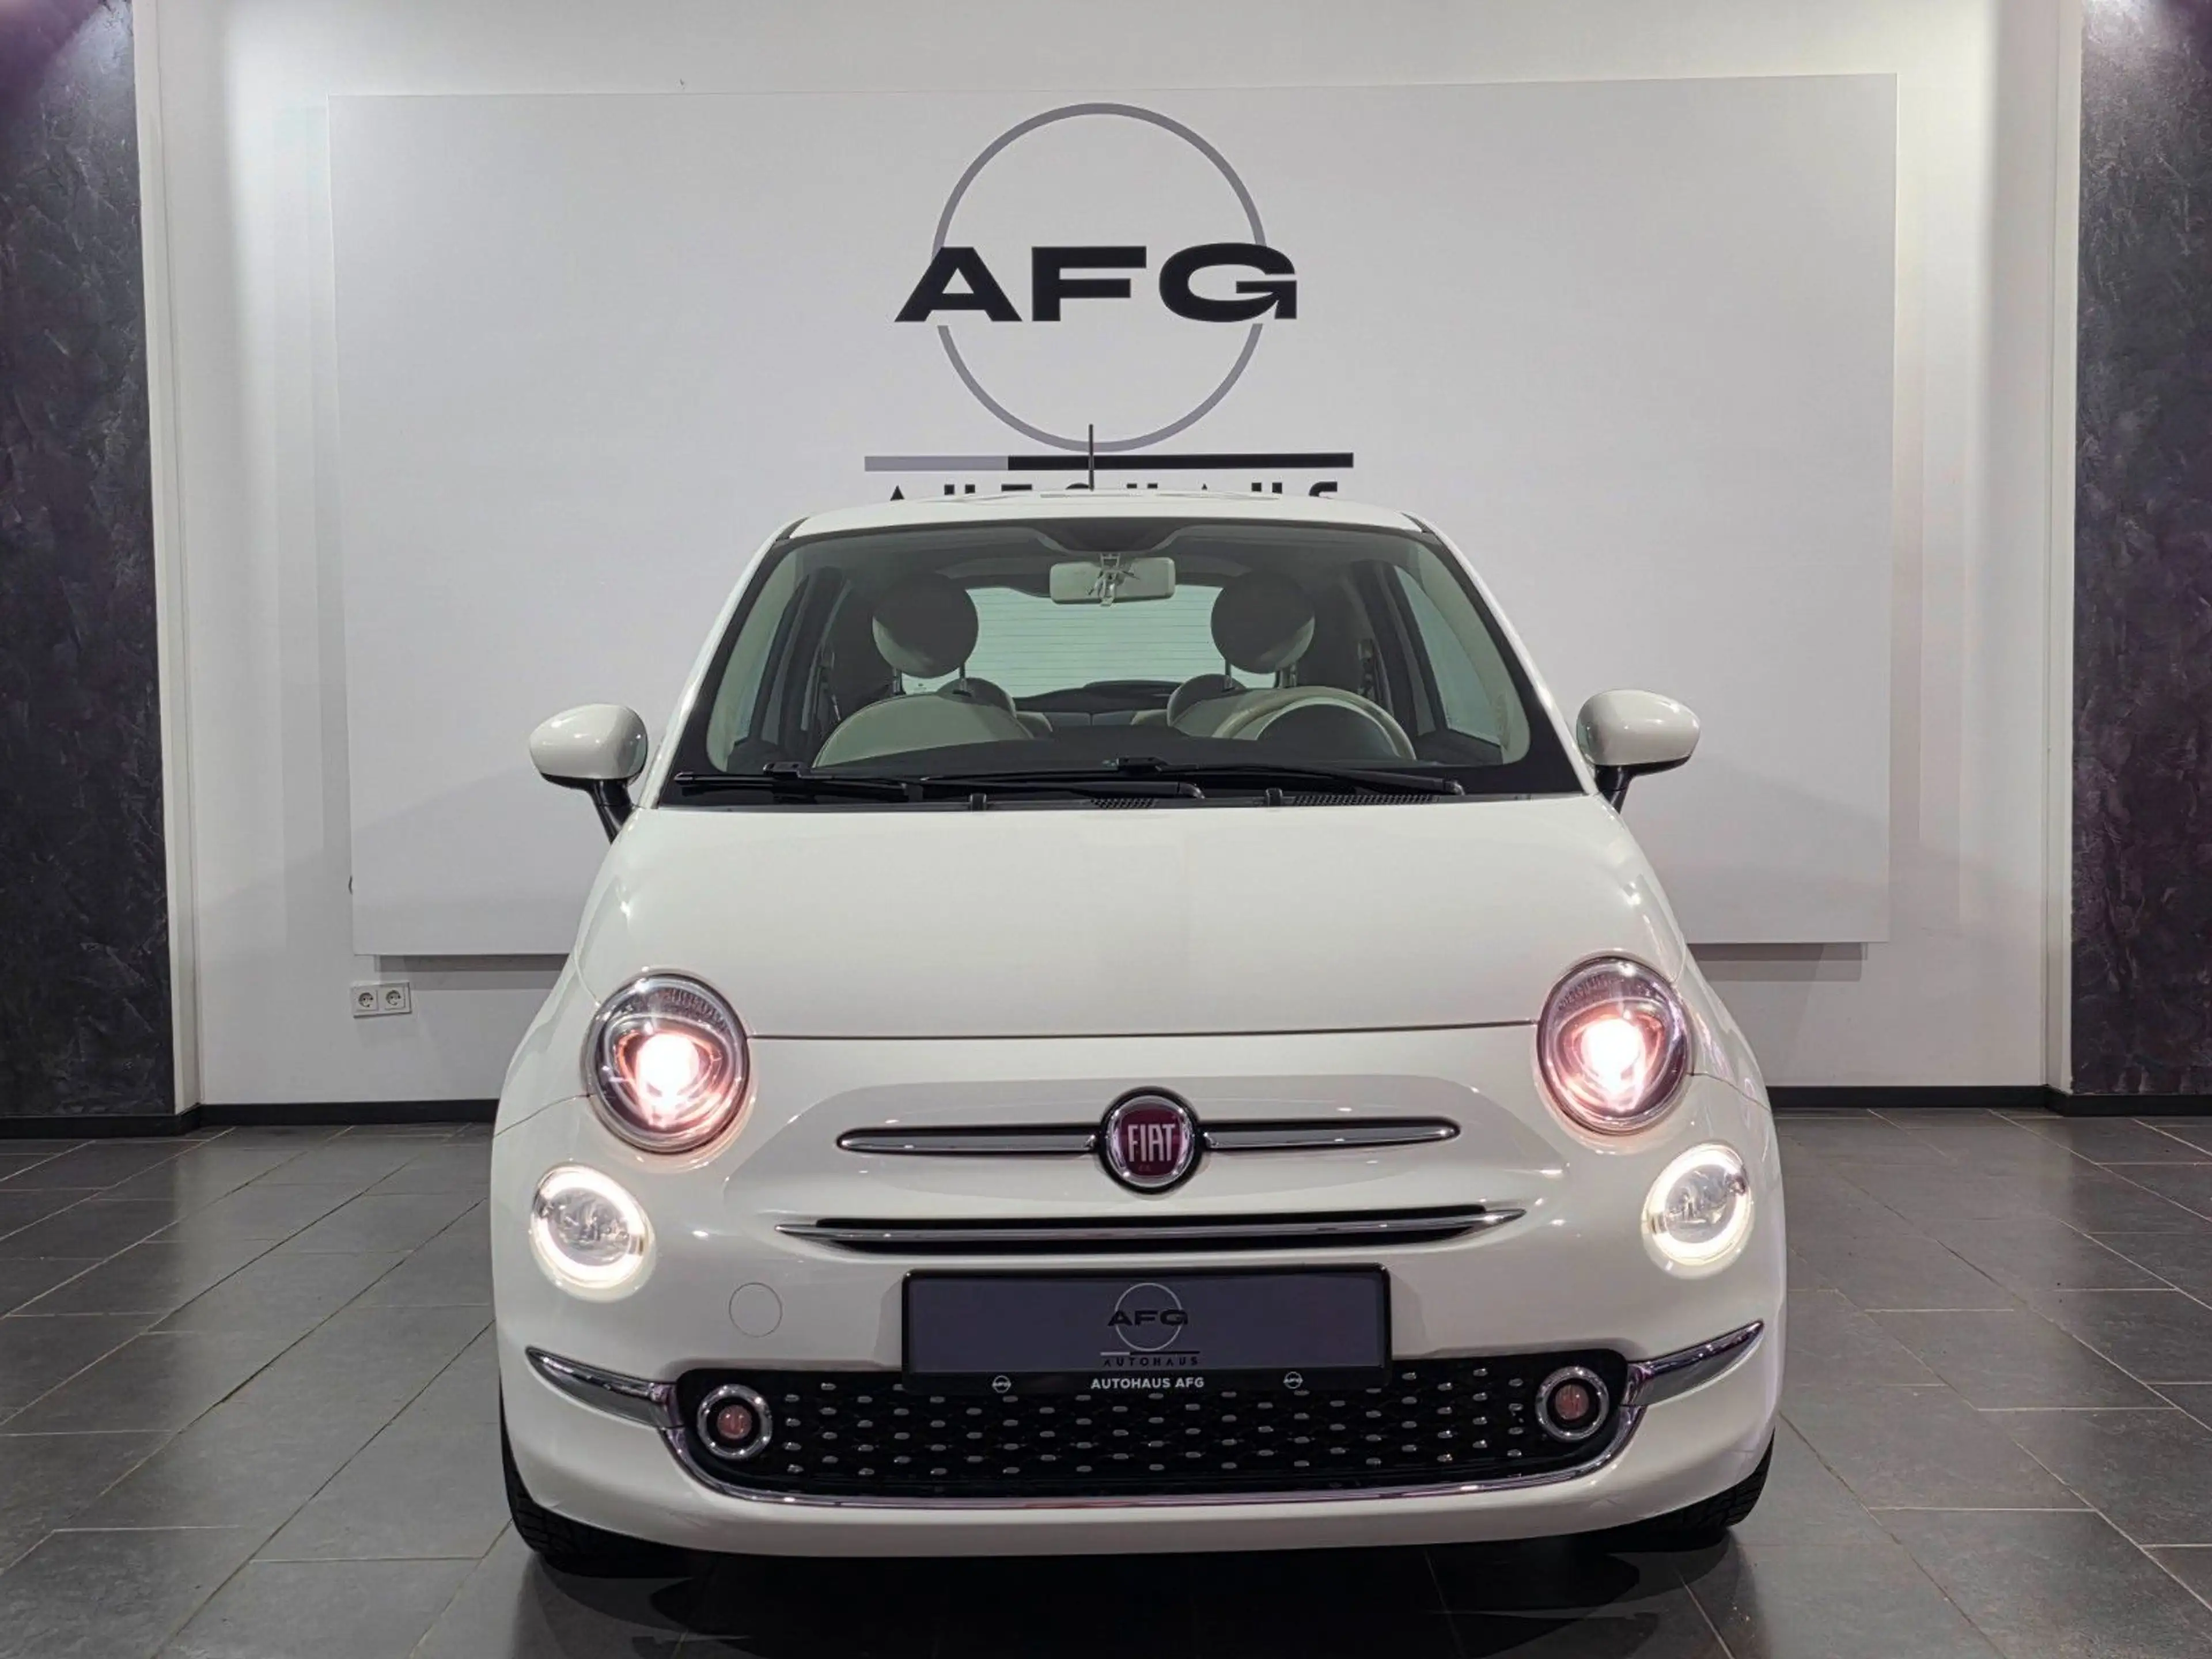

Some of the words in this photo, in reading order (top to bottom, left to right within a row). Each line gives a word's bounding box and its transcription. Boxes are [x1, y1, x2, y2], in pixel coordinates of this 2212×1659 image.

[894, 242, 1297, 323] AFG
[1127, 1124, 1176, 1162] FIAT
[1107, 1309, 1188, 1326] AFG
[1104, 1357, 1198, 1366] AUTOHAUS
[1090, 1378, 1171, 1389] AUTOHAUS
[1175, 1377, 1205, 1388] AFG
